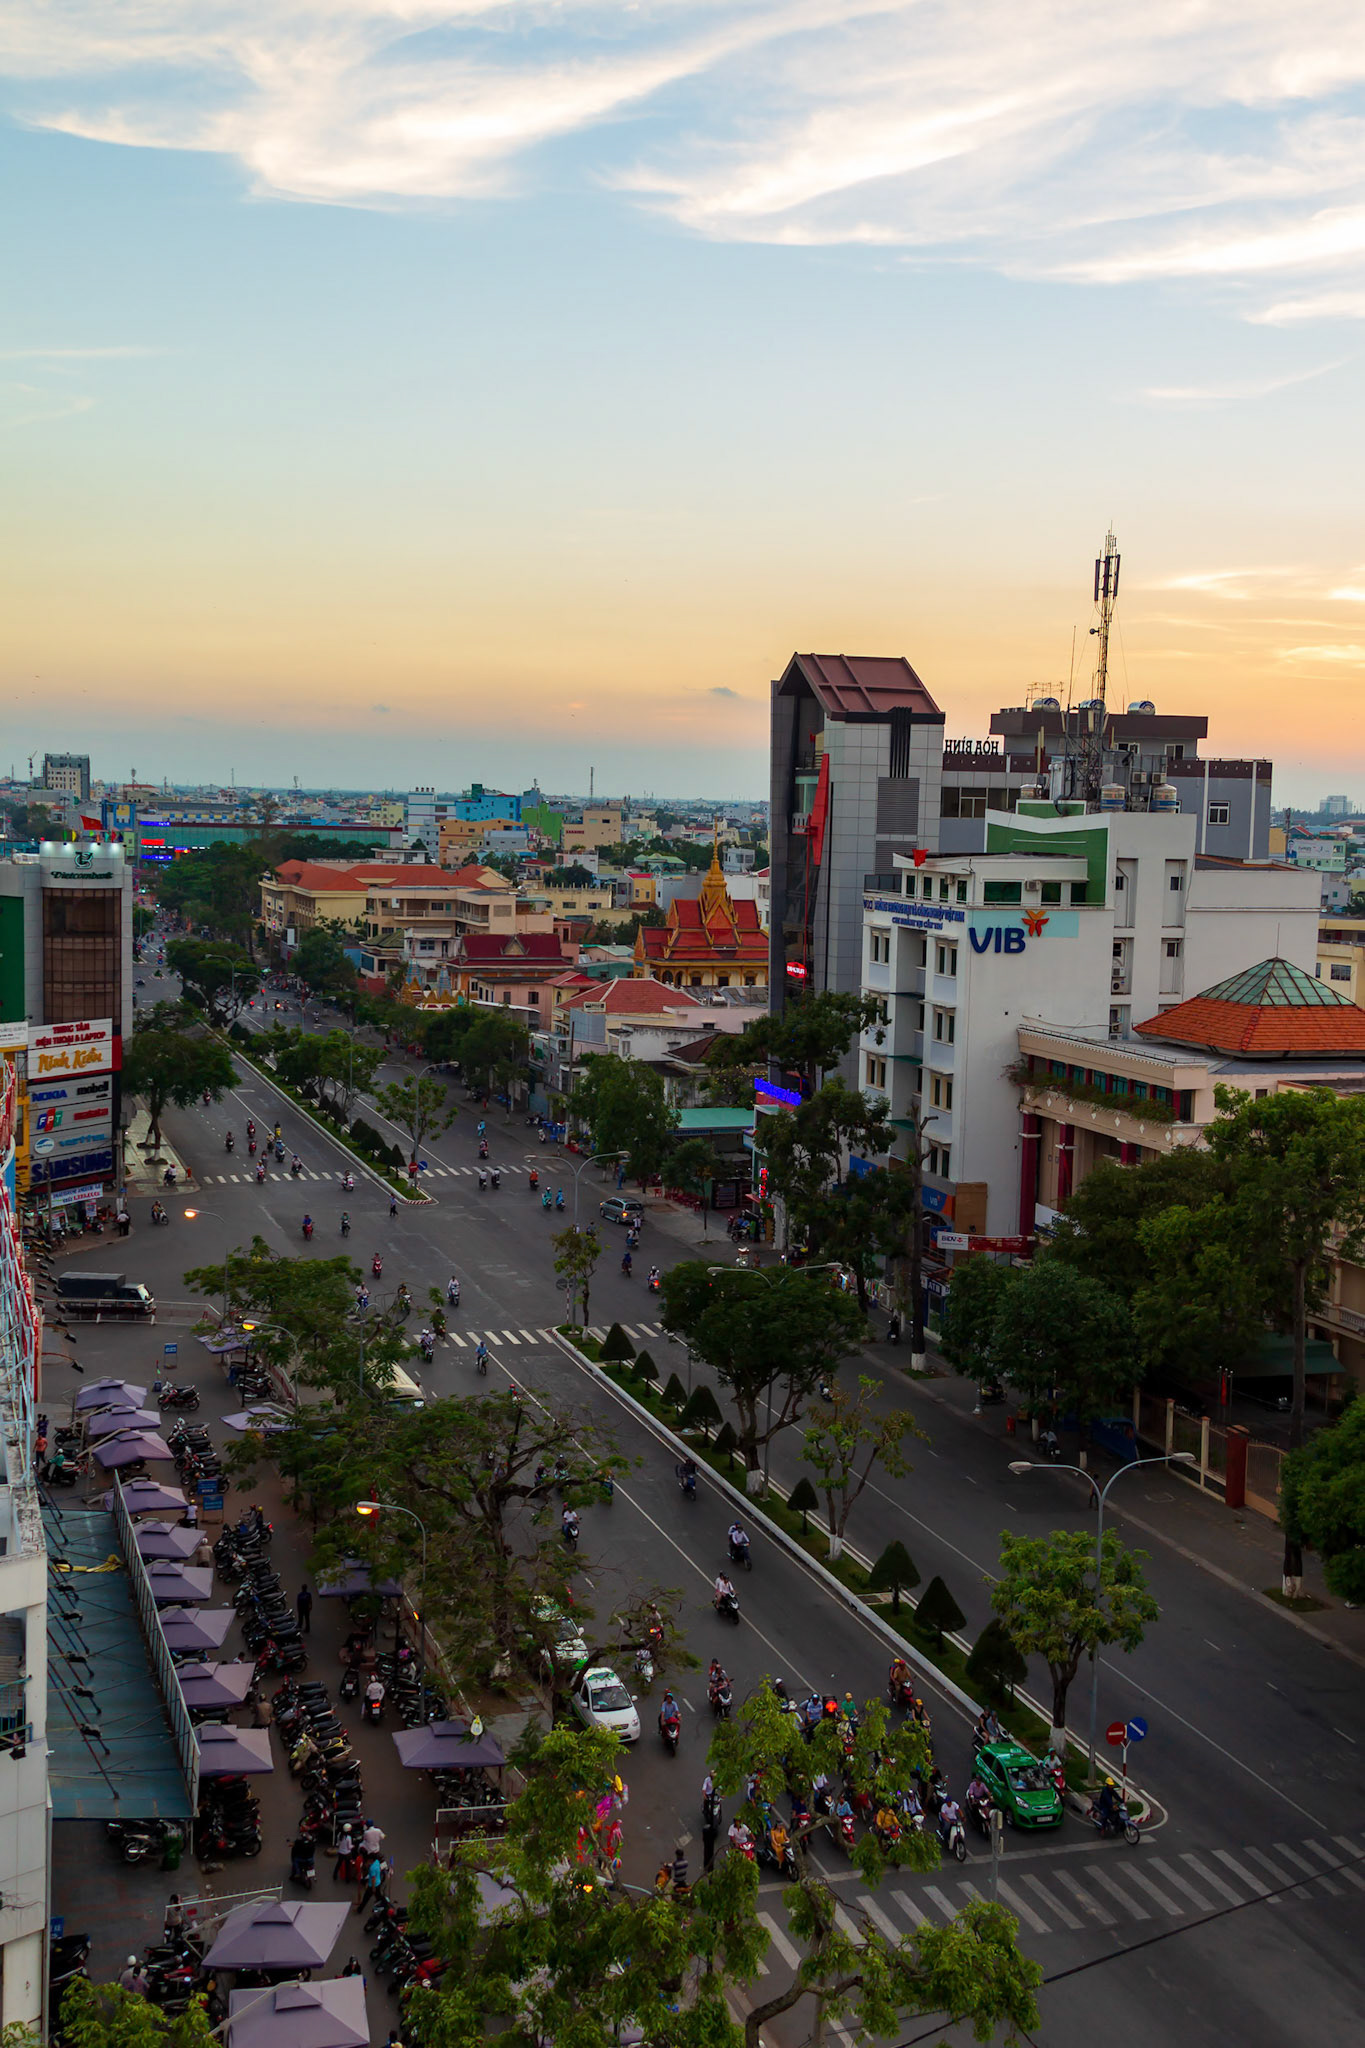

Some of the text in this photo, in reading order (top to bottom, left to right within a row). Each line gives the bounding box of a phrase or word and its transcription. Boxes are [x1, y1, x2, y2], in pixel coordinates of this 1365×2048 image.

[968, 927, 1026, 954] VIB
[81, 1031, 106, 1042] LAPTOP
[32, 1089, 68, 1102] NOKIA
[31, 1150, 112, 1182] SAMSUNG
